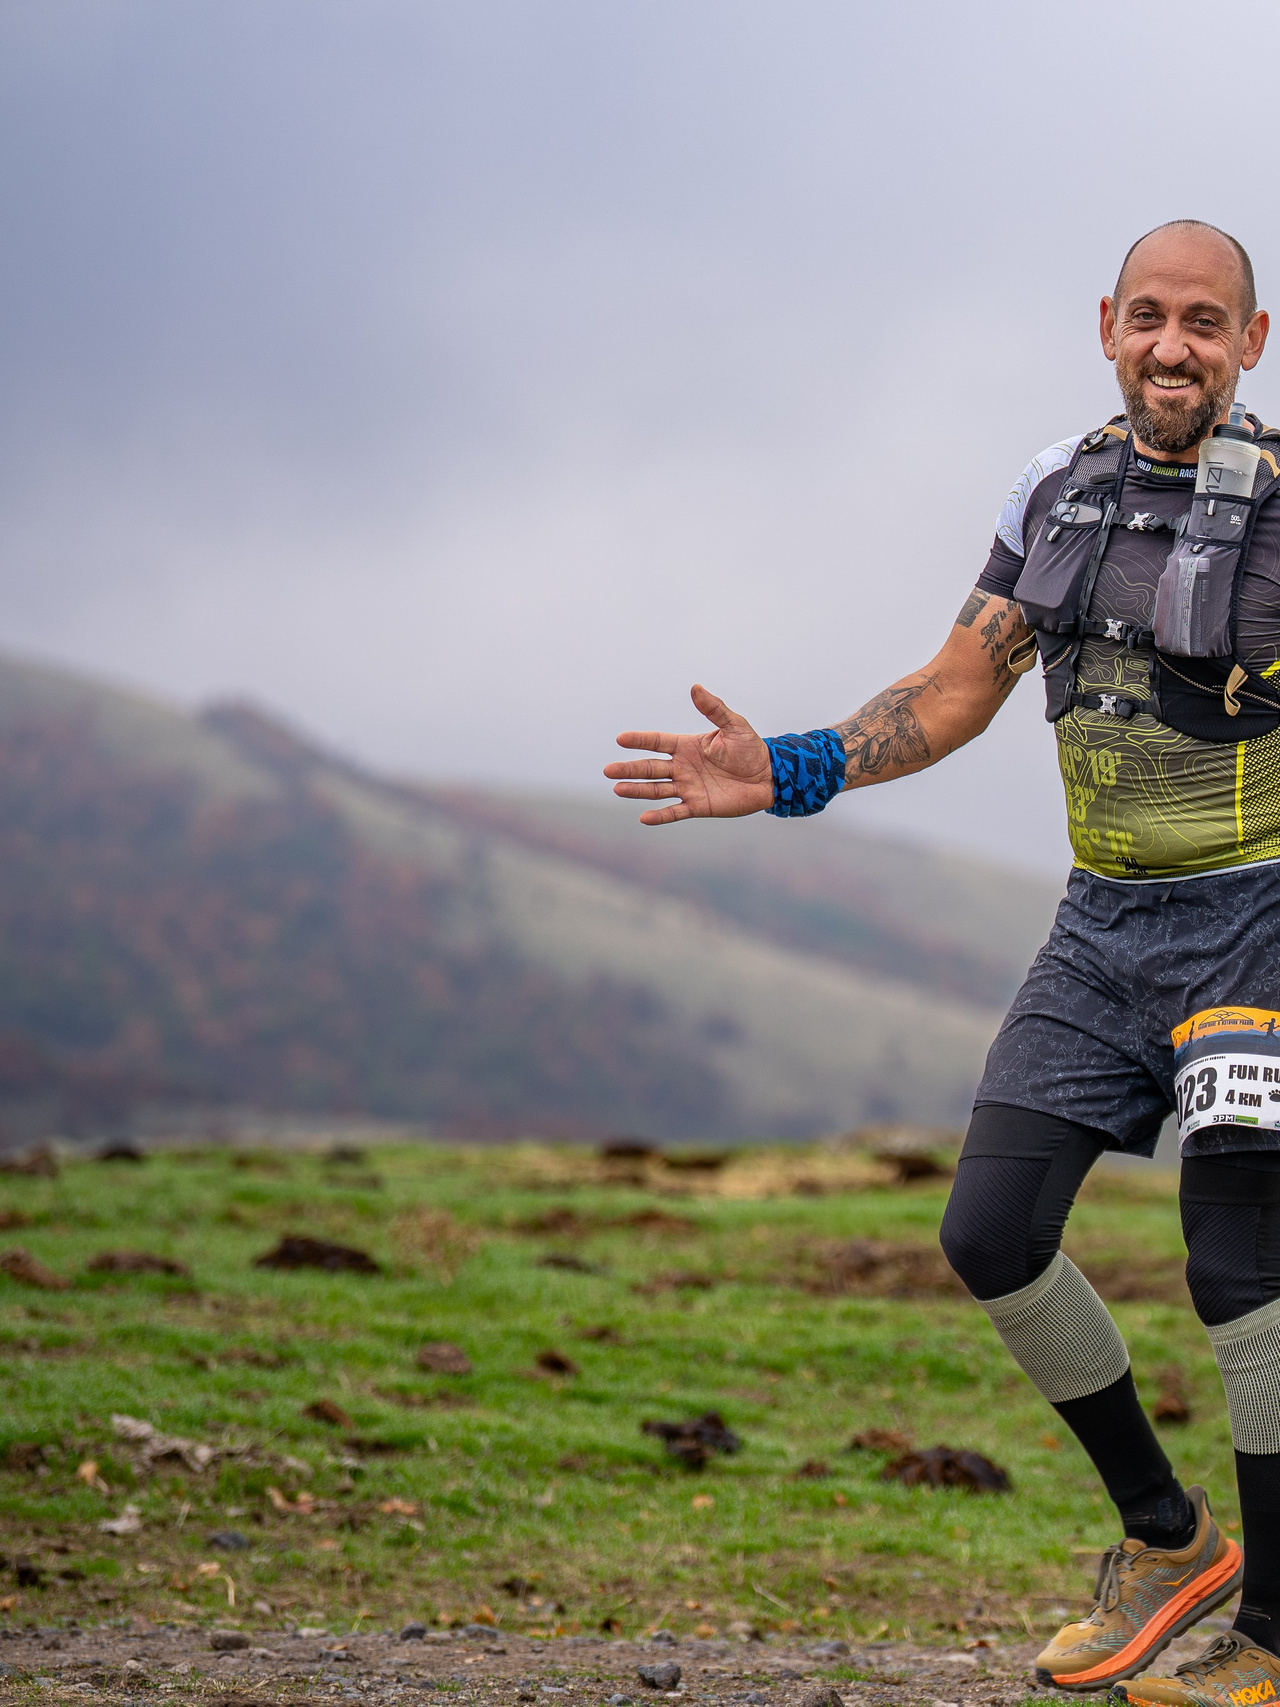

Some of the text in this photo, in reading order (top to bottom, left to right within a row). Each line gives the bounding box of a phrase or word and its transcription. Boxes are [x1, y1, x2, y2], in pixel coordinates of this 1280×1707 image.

[1137, 459, 1198, 478] GOLD BORDER RACE
[1228, 1065, 1258, 1081] FUN
[1225, 1089, 1262, 1108] 4 KM
[1229, 1679, 1276, 1706] HOKA
